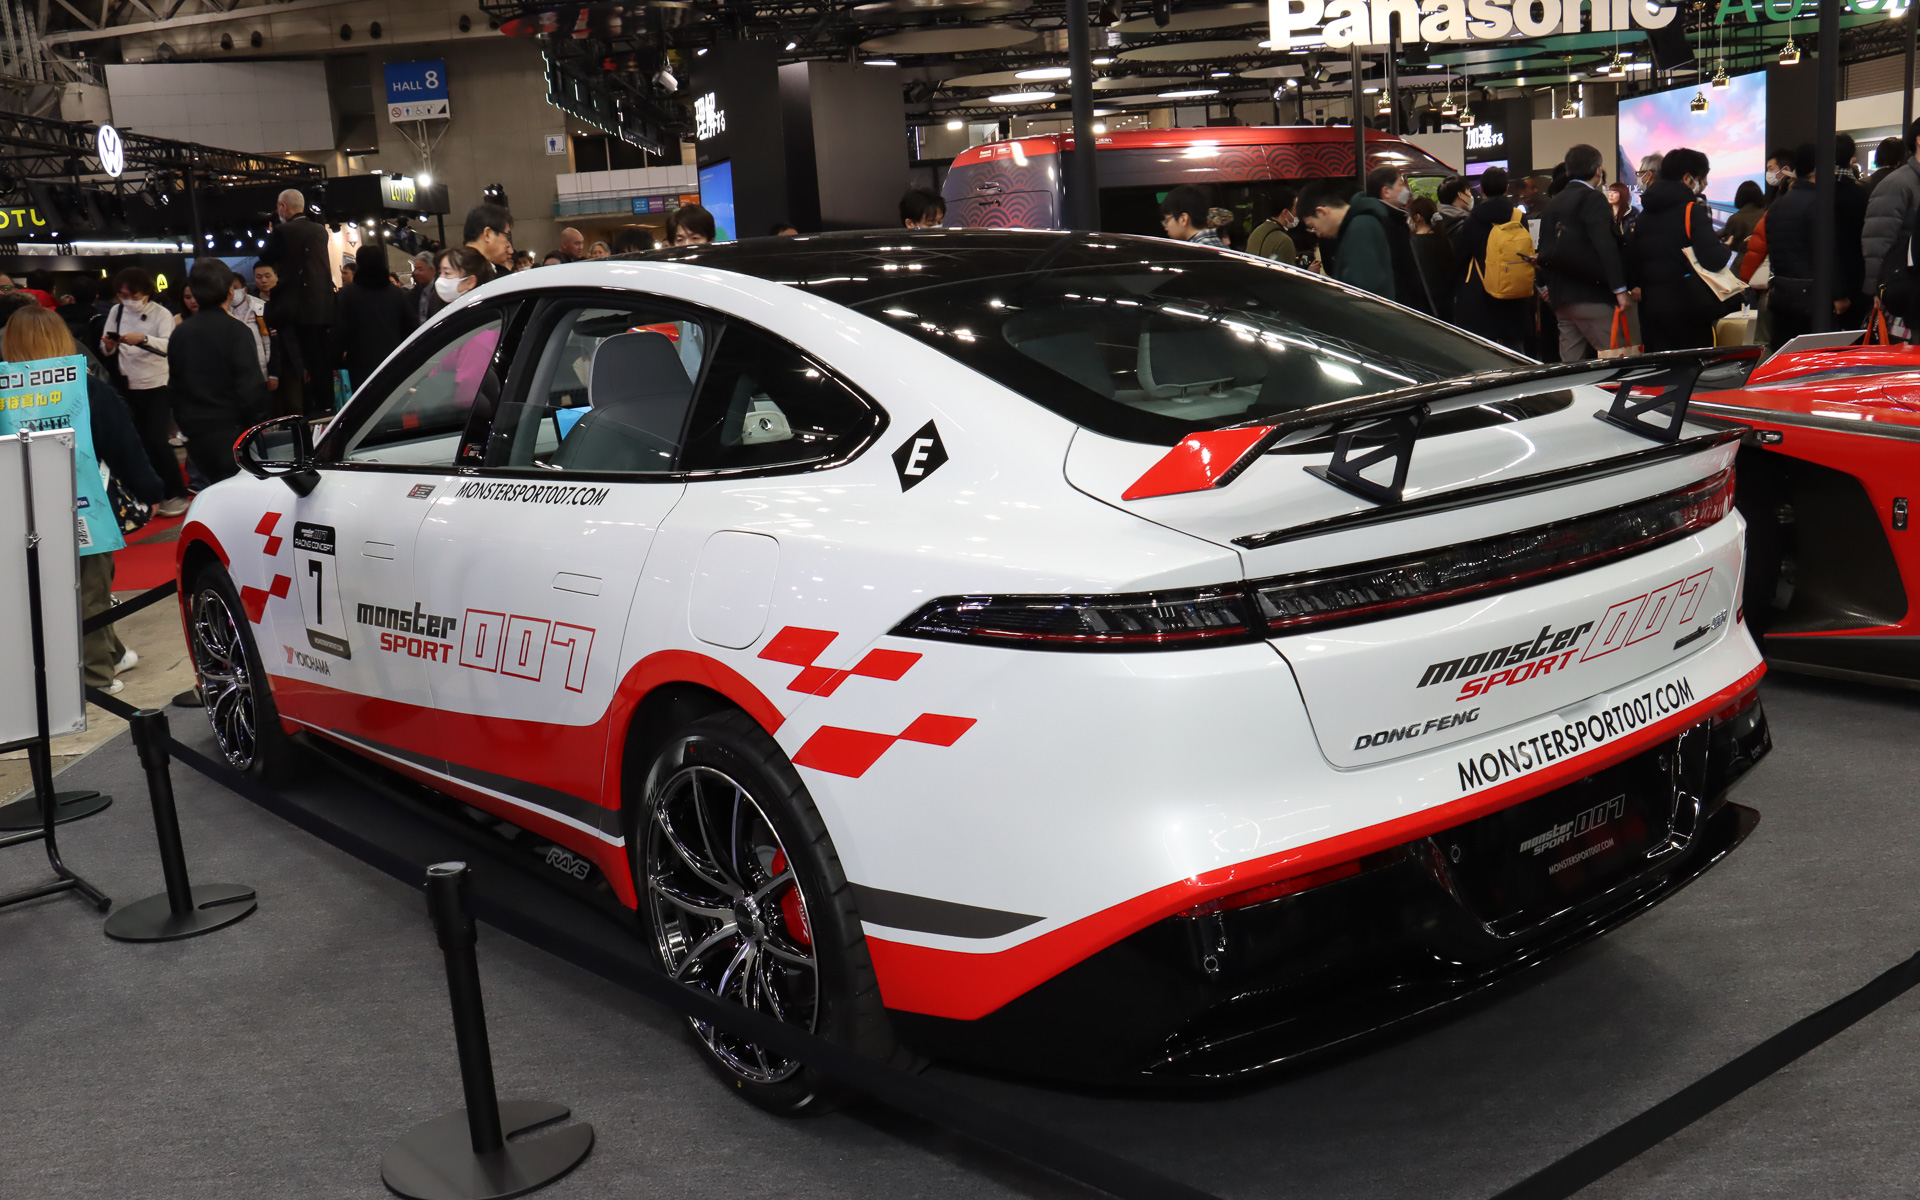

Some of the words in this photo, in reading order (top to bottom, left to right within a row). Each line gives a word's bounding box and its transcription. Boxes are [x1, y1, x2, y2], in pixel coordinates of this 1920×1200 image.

[1269, 0, 1677, 52] Panasonic
[393, 81, 422, 91] HALL
[425, 71, 439, 88] 8
[1466, 123, 1504, 149] 加速する
[30, 366, 77, 386] 2026
[904, 438, 934, 476] E
[455, 481, 610, 505] MONSTERSPORT007.COM
[308, 559, 323, 625] 7
[1416, 624, 1595, 688] monster
[1580, 567, 1714, 663] 007
[294, 650, 331, 676] YOKOHAMA
[357, 602, 457, 639] monster
[459, 608, 596, 694] 007
[380, 632, 454, 664] SPORT
[1455, 649, 1580, 702] SPORT
[1457, 676, 1695, 792] MONSTERSPORT007.COM
[1520, 820, 1574, 852] monster
[1574, 793, 1625, 838] 007
[1533, 831, 1573, 856] SPORT
[1548, 838, 1615, 875] MONSTERSPORT007.COM
[546, 847, 590, 880] RAYS
